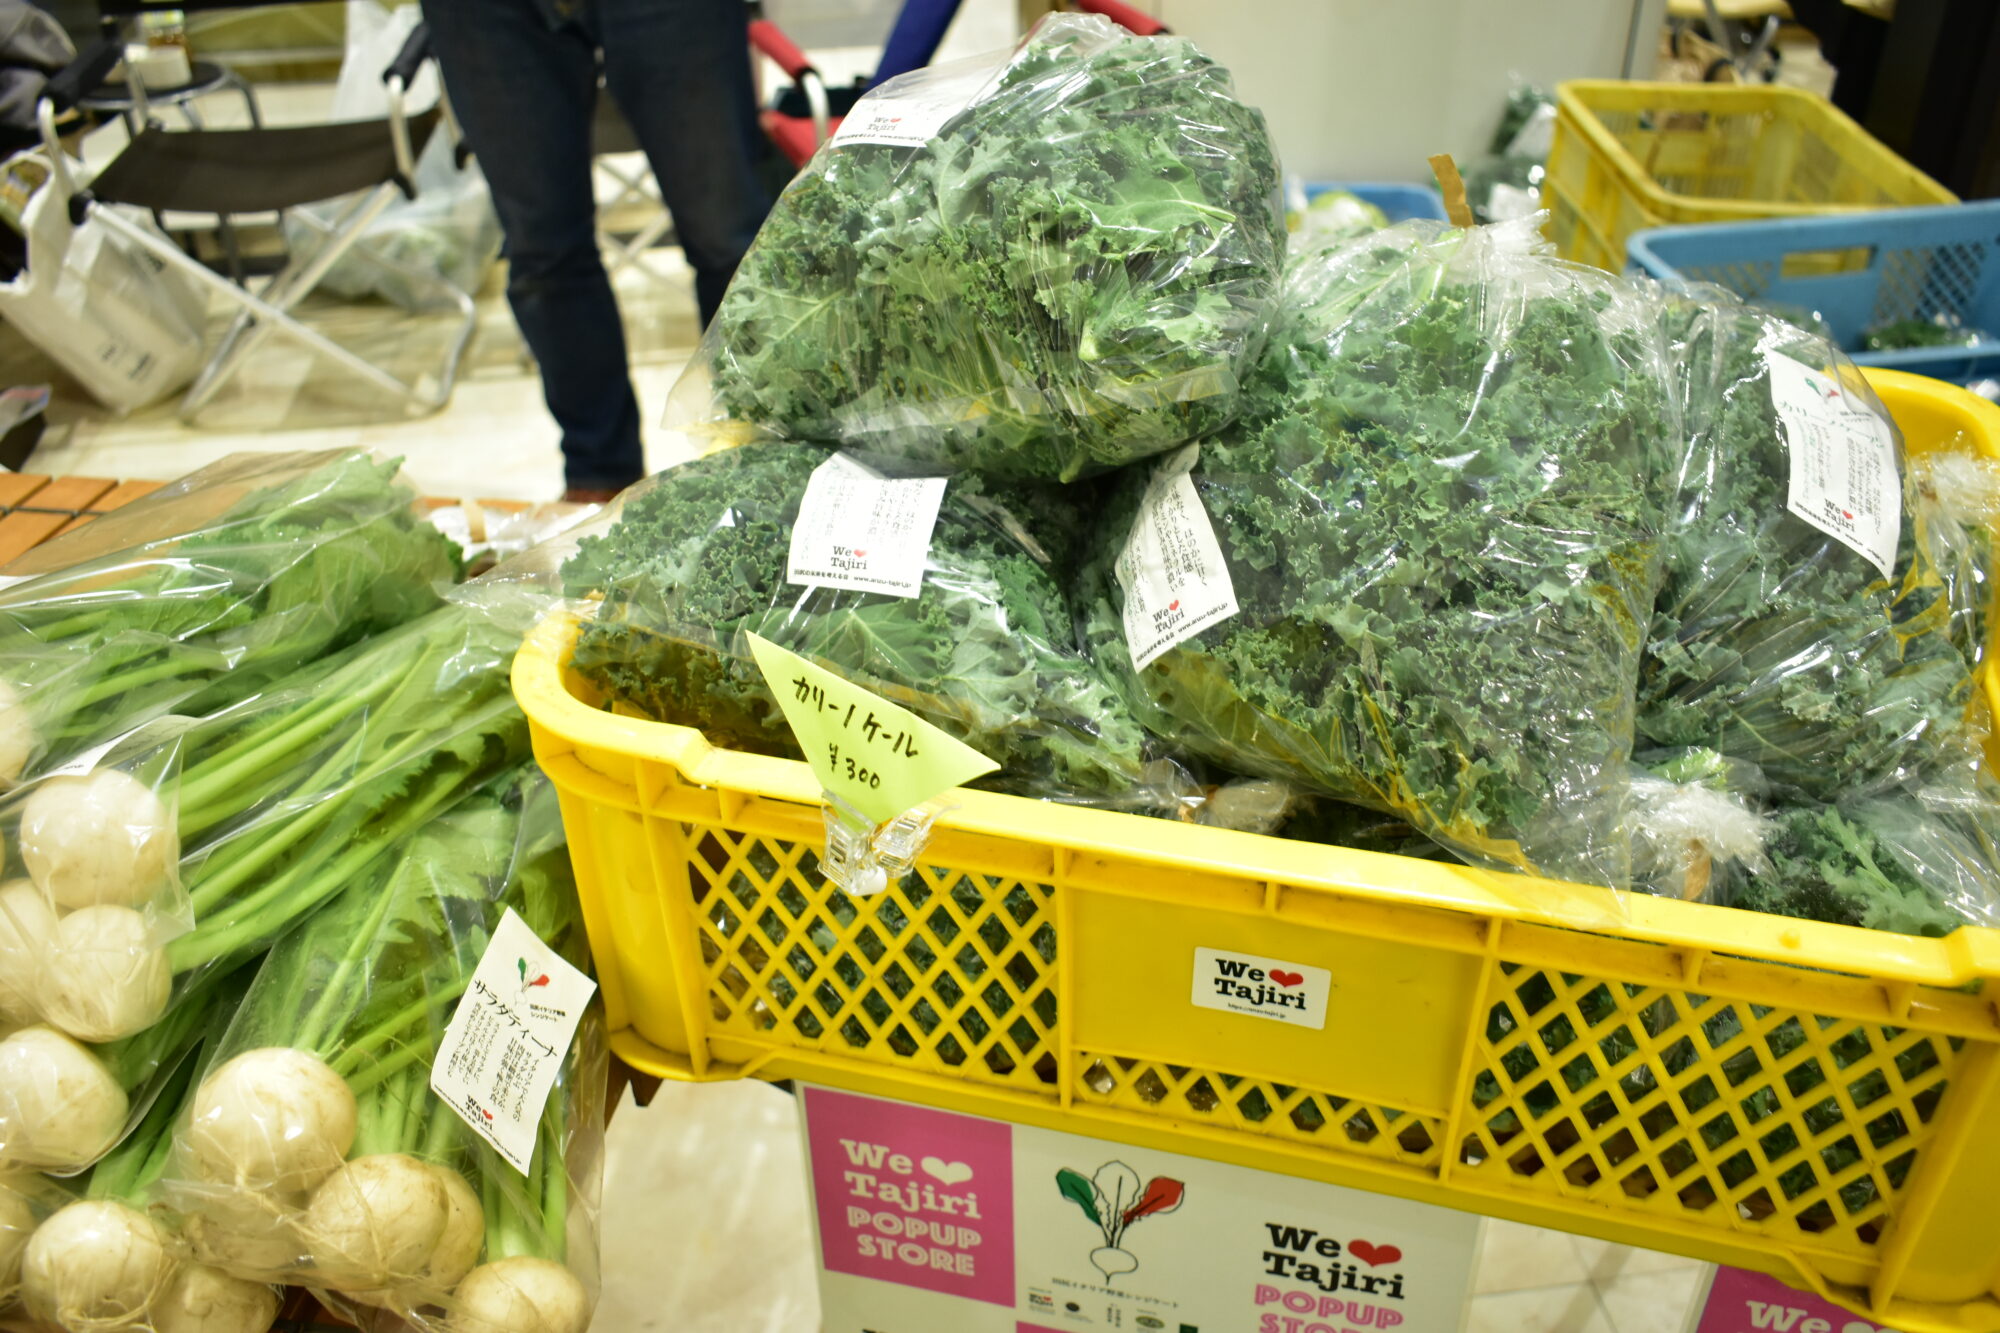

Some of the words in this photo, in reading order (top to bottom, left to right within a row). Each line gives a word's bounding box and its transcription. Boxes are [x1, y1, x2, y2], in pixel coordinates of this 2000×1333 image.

[1823, 508, 1856, 533] Tajiri
[1825, 498, 1841, 515] We
[830, 557, 867, 571] Tajiri
[833, 545, 852, 557] We
[1152, 608, 1170, 624] We
[1154, 607, 1185, 635] Tajiri
[1215, 958, 1265, 982] We
[1214, 977, 1307, 1011] Tajiri
[474, 979, 558, 1059] サラダティーナ
[465, 1103, 494, 1132] Tajiri
[466, 1094, 483, 1113] We
[839, 1138, 914, 1175] We
[844, 1170, 982, 1219] Tajiri
[847, 1205, 982, 1249] POPUP
[1265, 1222, 1341, 1258] We
[857, 1234, 976, 1277] STORE
[1262, 1250, 1405, 1300] Tajiri
[1254, 1283, 1404, 1330] POPUP
[1746, 1300, 1831, 1333] We
